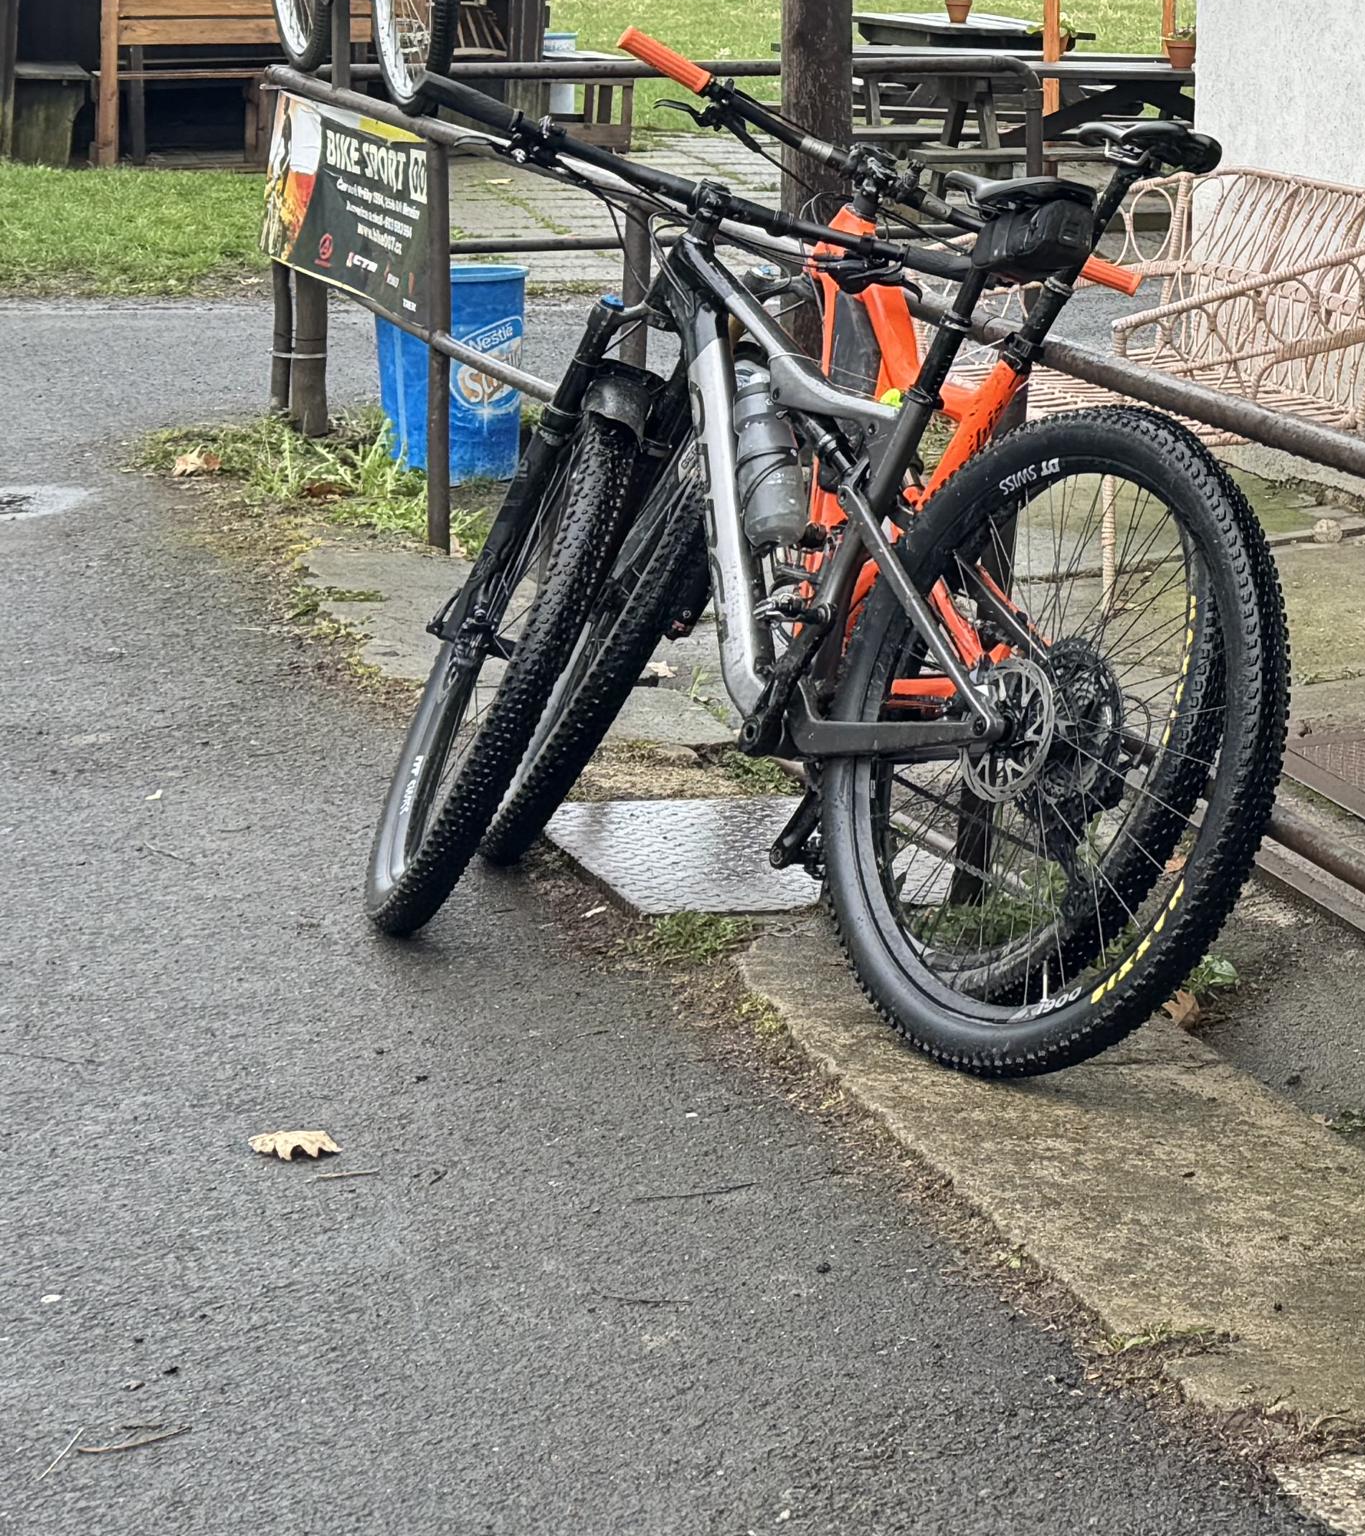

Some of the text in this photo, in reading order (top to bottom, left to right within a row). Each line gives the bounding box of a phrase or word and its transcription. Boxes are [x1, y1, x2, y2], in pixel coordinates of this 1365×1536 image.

[325, 128, 361, 175] BIKE
[362, 142, 407, 194] SPORT
[467, 321, 514, 352] Nestlé
[998, 464, 1038, 496] SWISS
